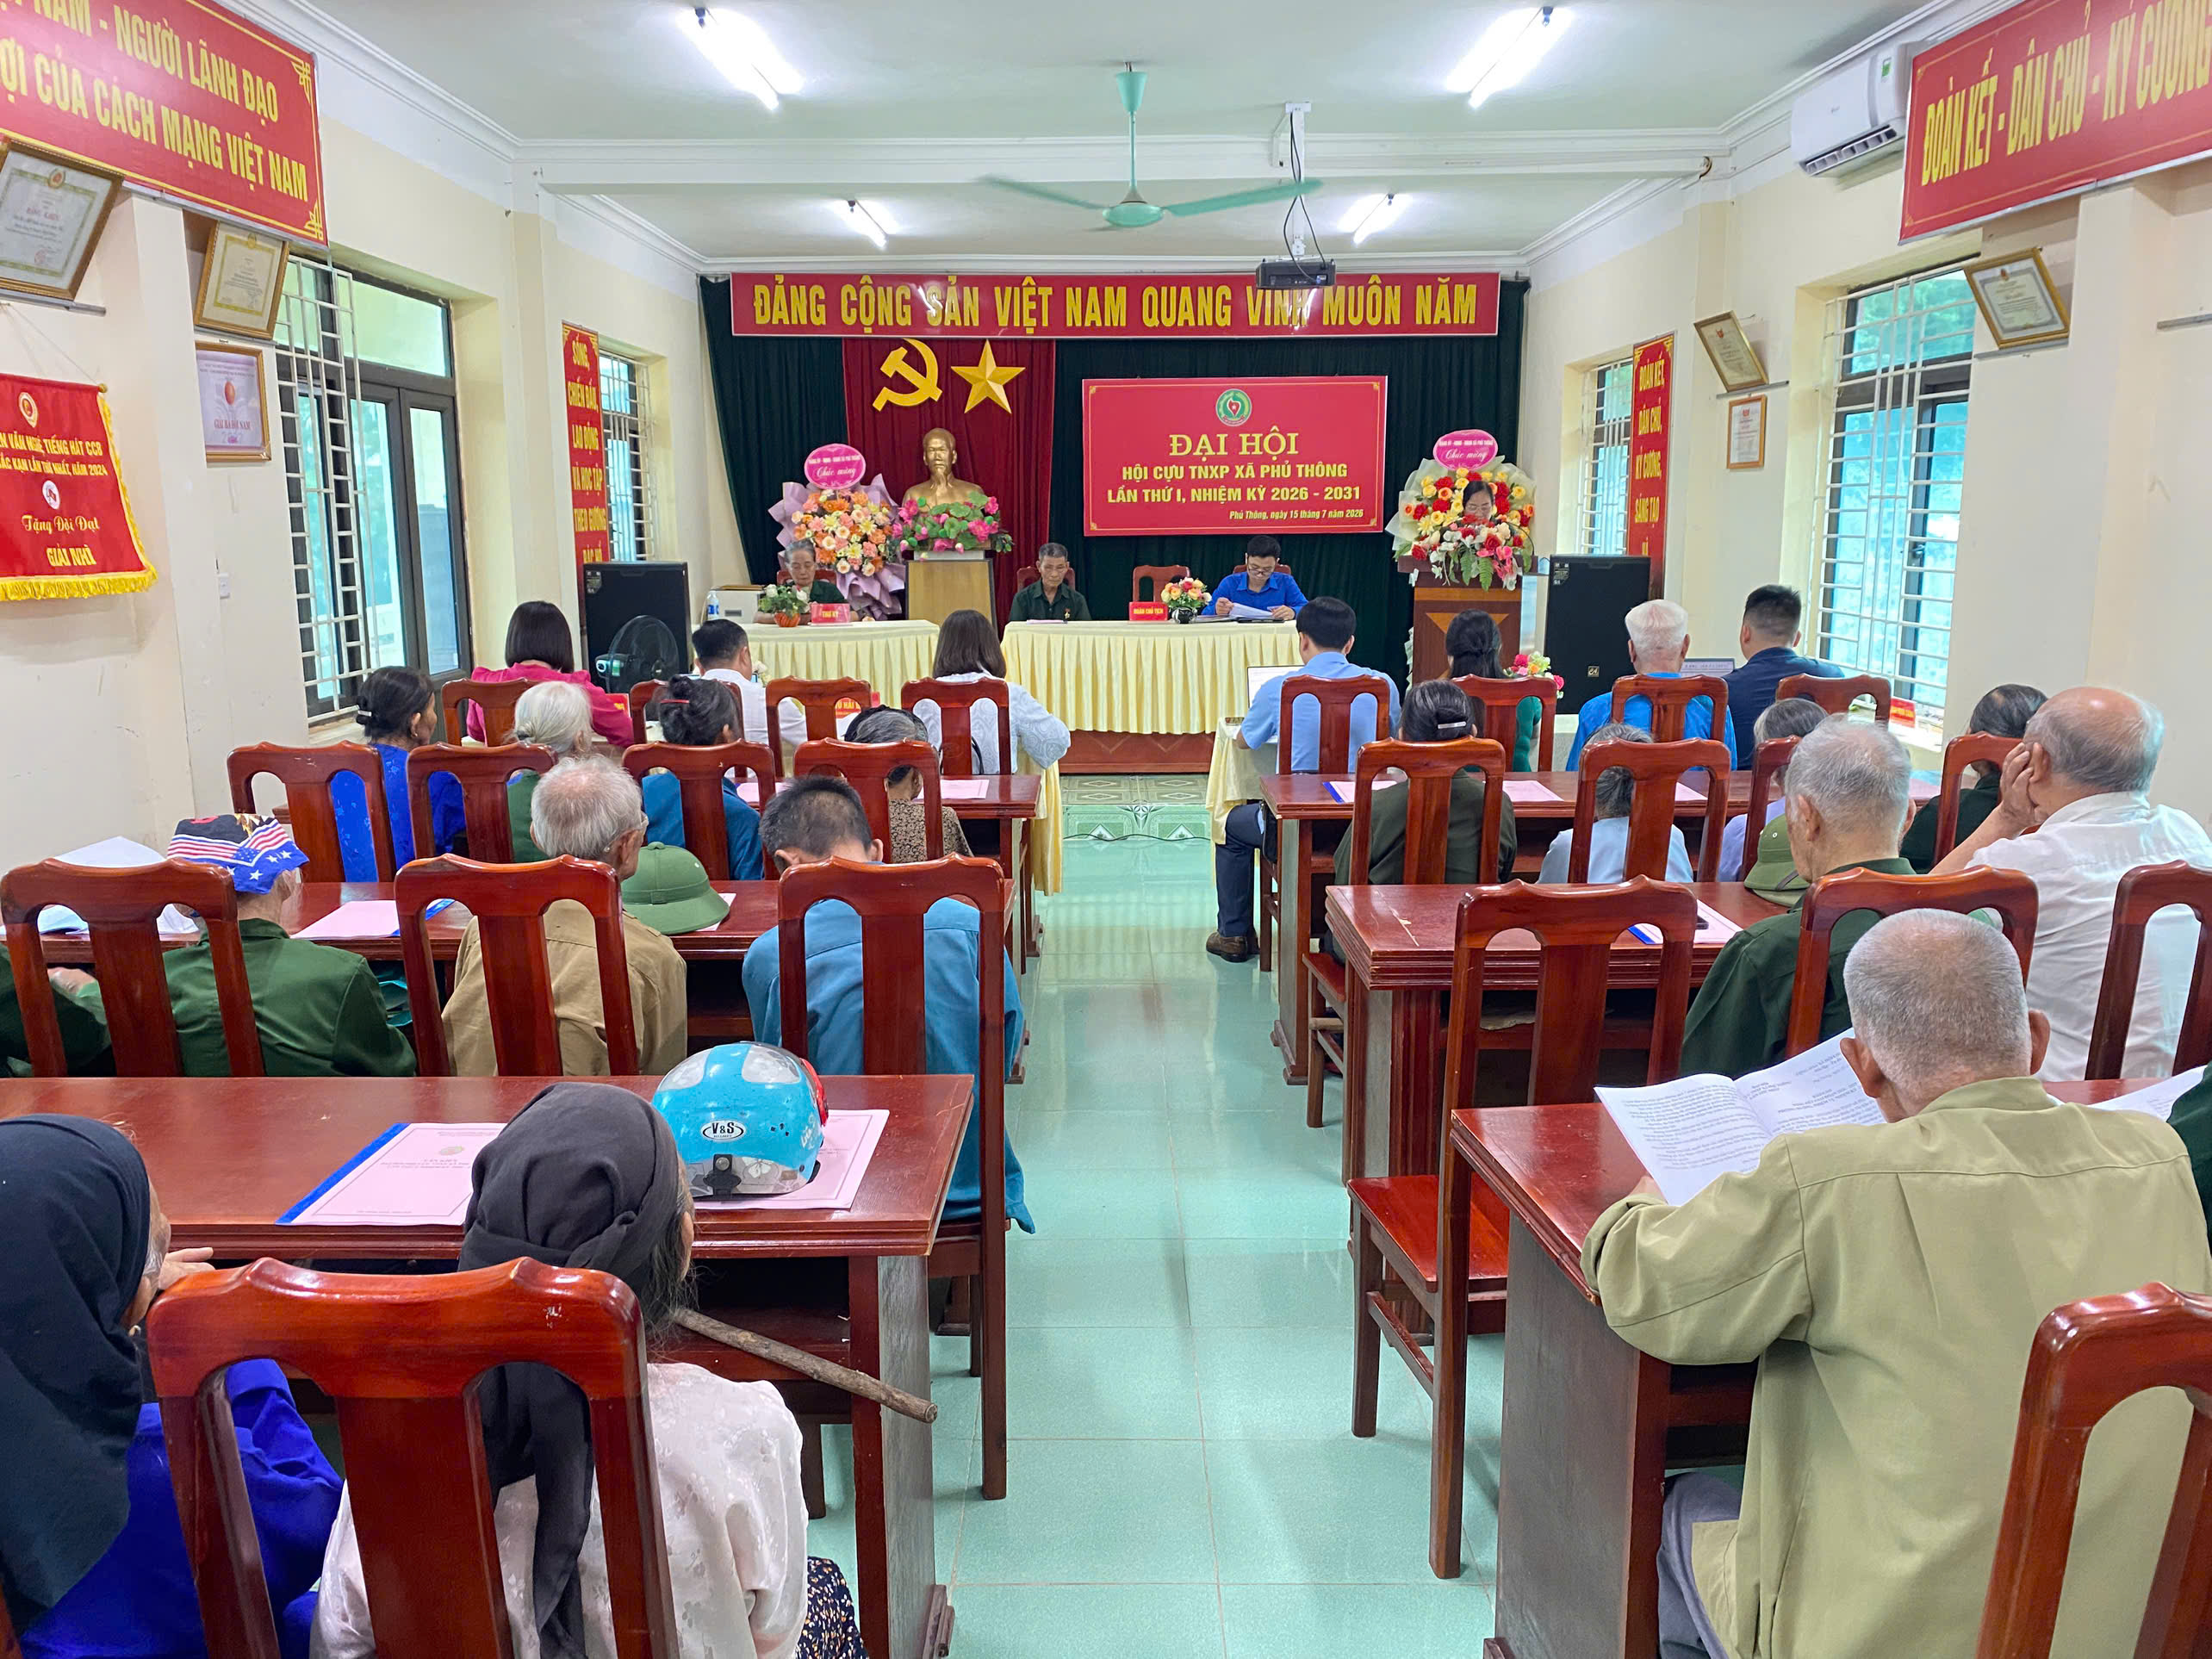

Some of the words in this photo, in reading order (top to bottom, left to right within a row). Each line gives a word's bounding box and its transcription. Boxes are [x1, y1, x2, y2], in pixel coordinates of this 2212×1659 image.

[114, 4, 183, 80] NGƯỜI
[187, 39, 239, 105] LÃNH
[242, 68, 278, 127] ĐẠO
[1922, 76, 1966, 186] ĐOÀN
[1964, 47, 1998, 171] KẾT
[2007, 37, 2048, 157] DÂN
[2047, 0, 2091, 141] CHỦ
[34, 43, 89, 119] CỦA
[94, 76, 157, 146] CÁCH
[161, 105, 223, 169] MẠNG
[226, 132, 264, 192] VIỆT
[269, 150, 308, 202] NAM
[754, 275, 826, 325] ĐẢNG
[841, 275, 911, 334] CỘNG
[926, 276, 979, 326] SẢN
[994, 276, 1053, 334] VIỆT
[1066, 286, 1126, 327] NAM
[1142, 285, 1231, 327] QUANG
[1246, 285, 1309, 326] VINH
[1322, 274, 1401, 326] MUÔN
[1415, 276, 1477, 325] NĂM
[42, 434, 71, 456] TIẾNG
[69, 437, 84, 456] HÁT
[85, 440, 103, 456] CCB
[1169, 433, 1228, 462] ĐẠI
[1239, 425, 1299, 461] HỘI
[88, 463, 109, 475] 2024
[1122, 463, 1148, 482] HỘI
[1153, 464, 1184, 482] CỰU
[1189, 465, 1230, 480] TNXP
[1234, 463, 1255, 478] XÃ
[1260, 460, 1291, 478] PHỦ
[1296, 461, 1348, 477] THÔNG
[1142, 486, 1173, 502] THỨ
[1177, 489, 1186, 504] I,
[1190, 485, 1241, 504] NHIỆM
[1246, 485, 1266, 501] KỲ
[1271, 487, 1309, 500] 2026
[1324, 486, 1360, 500] 2031
[22, 514, 53, 535] Tặng
[53, 515, 75, 534] Đội
[1270, 511, 1288, 520] ngày
[1289, 510, 1299, 519] 15
[1300, 510, 1320, 519] tháng
[1345, 509, 1364, 518] 2026
[46, 543, 71, 567] GIẢI
